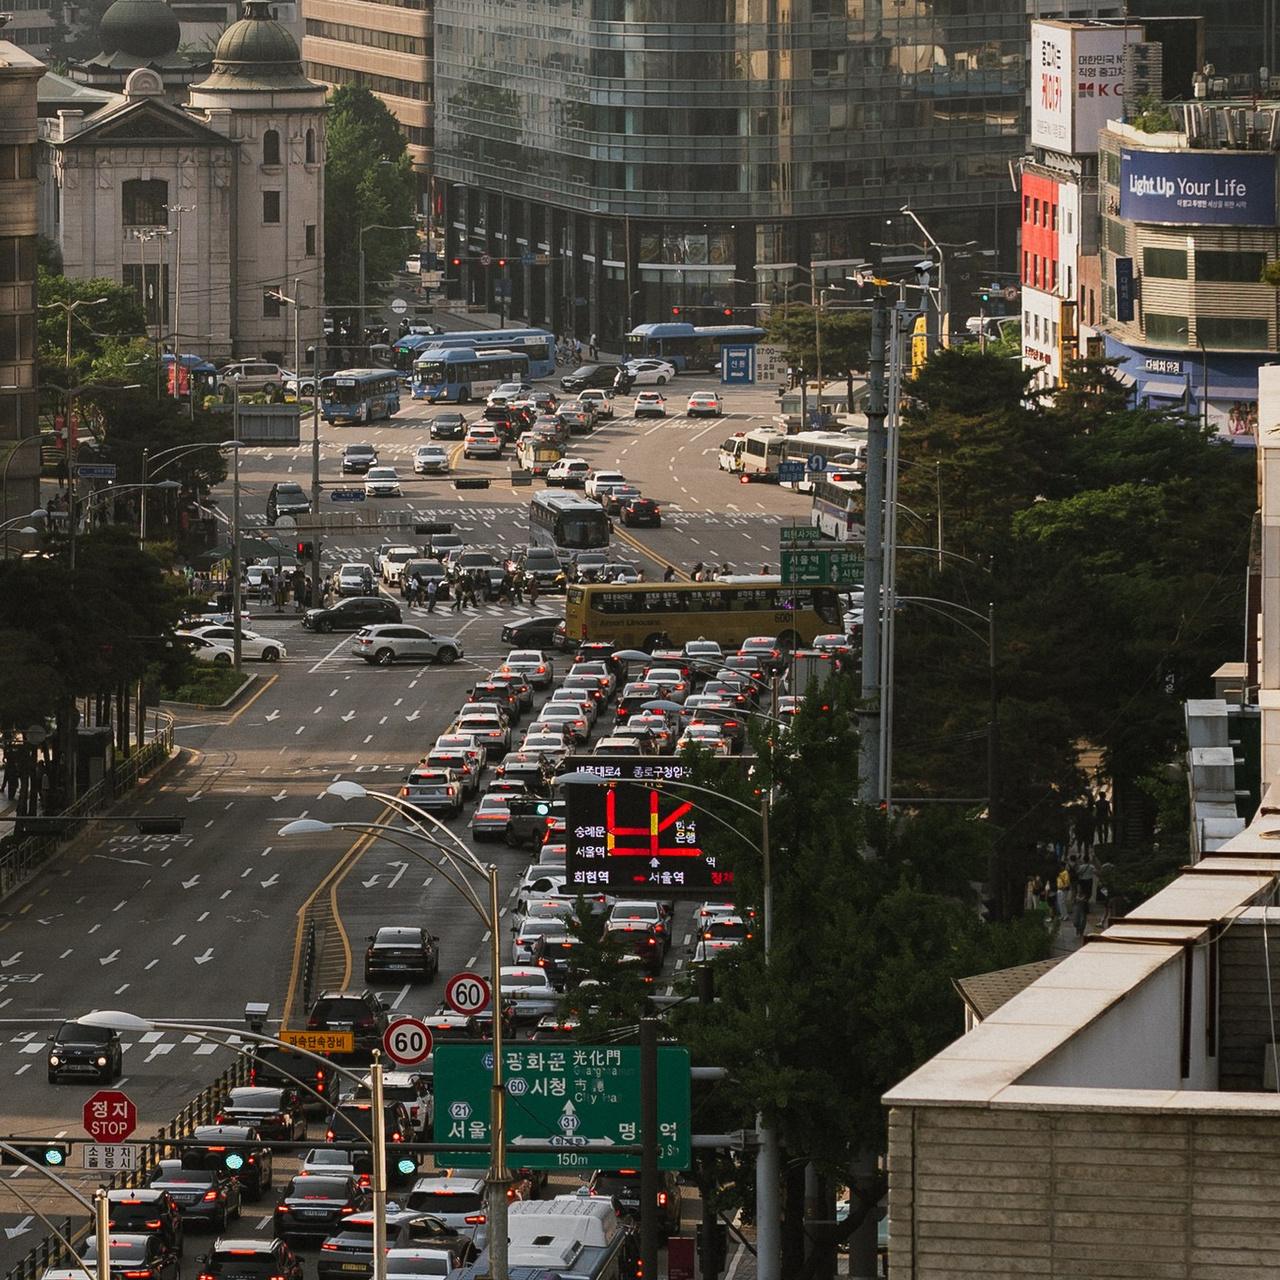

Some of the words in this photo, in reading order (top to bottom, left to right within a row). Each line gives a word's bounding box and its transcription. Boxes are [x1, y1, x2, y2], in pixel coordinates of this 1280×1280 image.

[1079, 54, 1115, 65] 대한민국
[1130, 174, 1156, 197] Light
[1156, 176, 1176, 198] Up
[1176, 177, 1211, 196] Your
[1215, 179, 1247, 197] Life
[575, 846, 606, 858] 서울역
[573, 871, 610, 884] 회현역
[649, 871, 685, 885] 서울역
[455, 983, 481, 1006] 60
[289, 1035, 346, 1048] 과속단속장비
[394, 1032, 423, 1052] 60
[506, 1052, 566, 1072] 광화문
[572, 1050, 621, 1066] 光化門
[510, 1081, 523, 1092] 60
[530, 1077, 566, 1097] 시청
[91, 1100, 128, 1118] 정지
[454, 1104, 468, 1116] 21
[91, 1121, 128, 1134] STOP
[563, 1117, 576, 1128] 31
[448, 1121, 493, 1140] 서울
[557, 1154, 589, 1166] 150m
